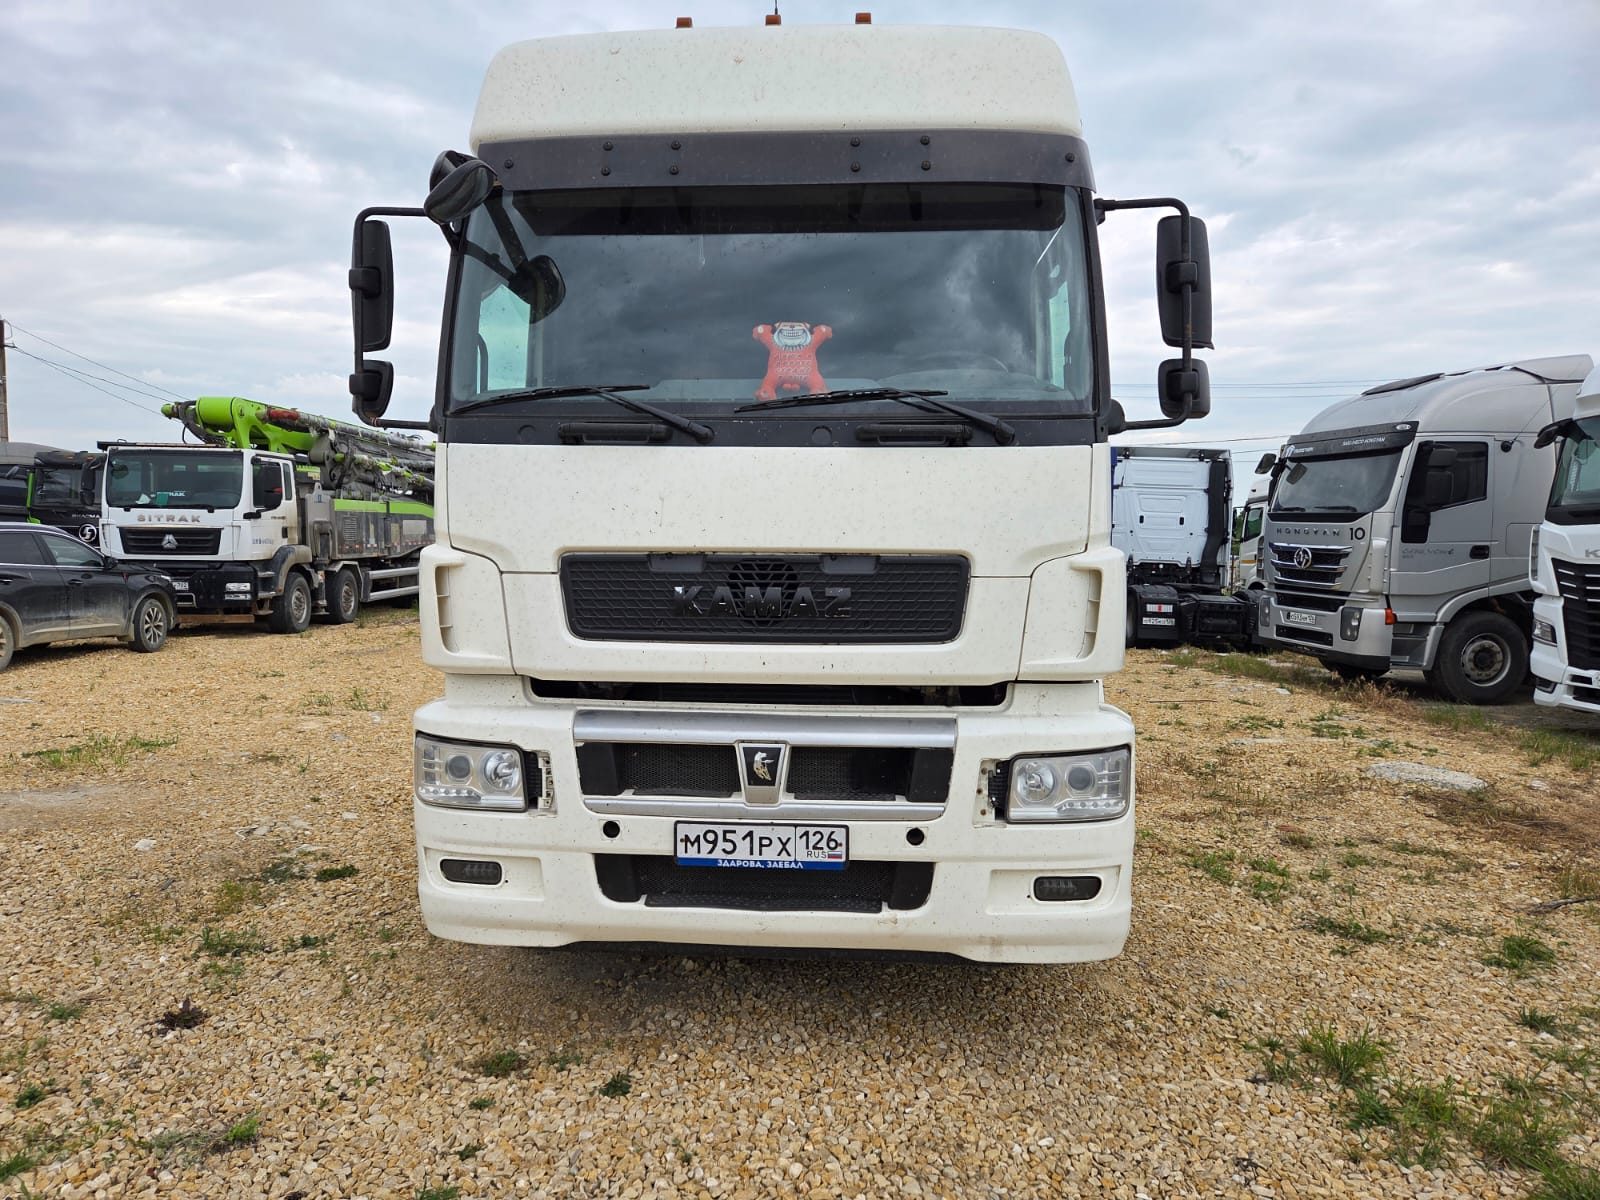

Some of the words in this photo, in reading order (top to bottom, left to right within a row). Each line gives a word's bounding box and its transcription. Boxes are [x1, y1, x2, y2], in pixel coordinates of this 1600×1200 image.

[137, 514, 201, 523] SITRAK
[1276, 527, 1340, 537] HONGYAN
[1349, 527, 1366, 541] 10
[672, 585, 853, 618] KAMAZ
[684, 829, 792, 857] М951РХ
[799, 830, 838, 851] 126
[806, 850, 827, 859] RUS
